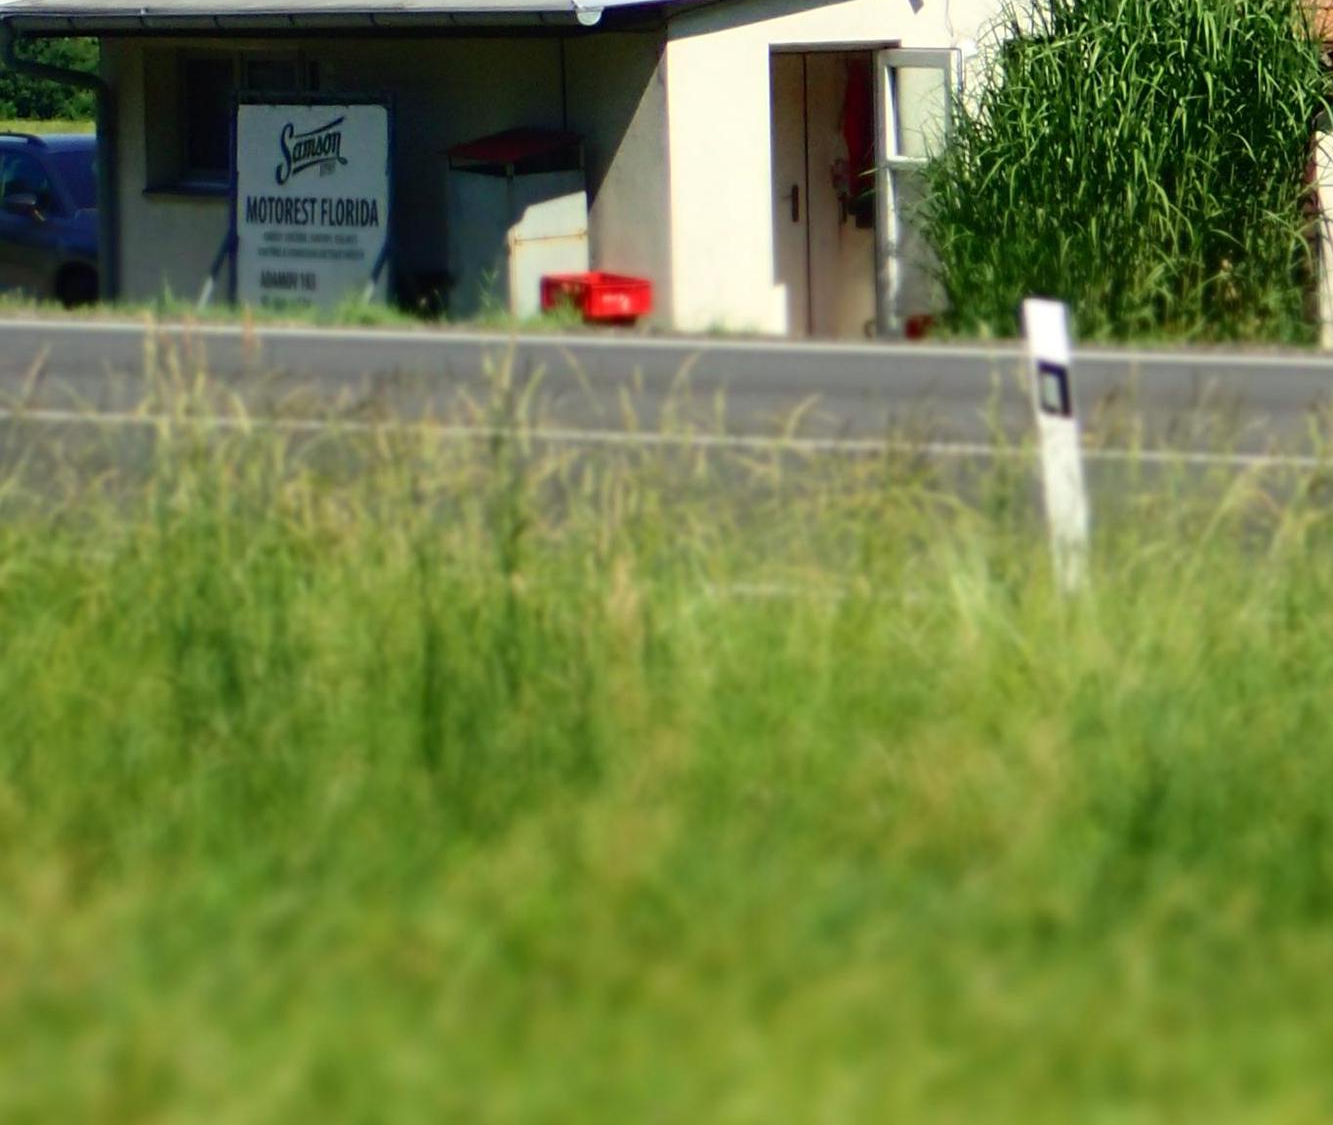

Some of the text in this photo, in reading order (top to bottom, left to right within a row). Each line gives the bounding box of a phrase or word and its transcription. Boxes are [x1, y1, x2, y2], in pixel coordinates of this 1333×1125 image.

[276, 116, 348, 185] Samson
[246, 195, 379, 227] MOTOREST FLORIDA
